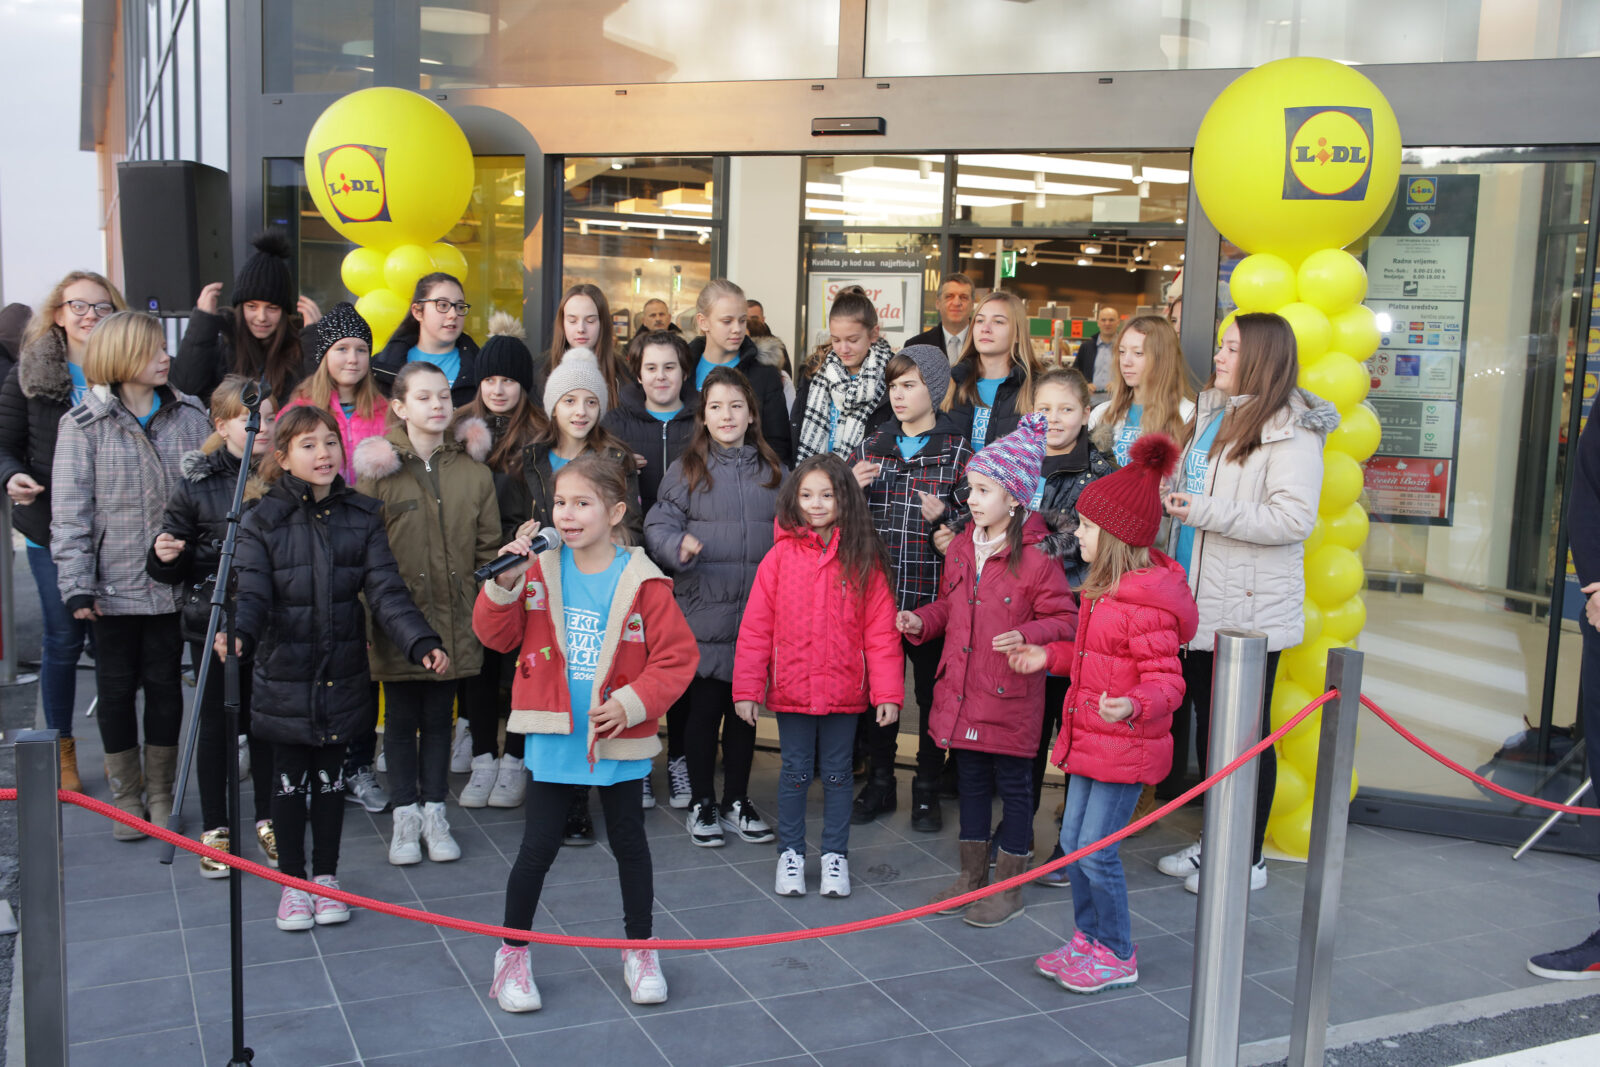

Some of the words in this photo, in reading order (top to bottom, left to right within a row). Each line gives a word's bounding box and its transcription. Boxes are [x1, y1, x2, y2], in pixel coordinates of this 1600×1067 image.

[812, 259, 840, 267] Kvaliteta
[841, 259, 848, 268] je
[850, 259, 861, 267] kod
[827, 285, 882, 302] Ser
[568, 614, 600, 632] EKI
